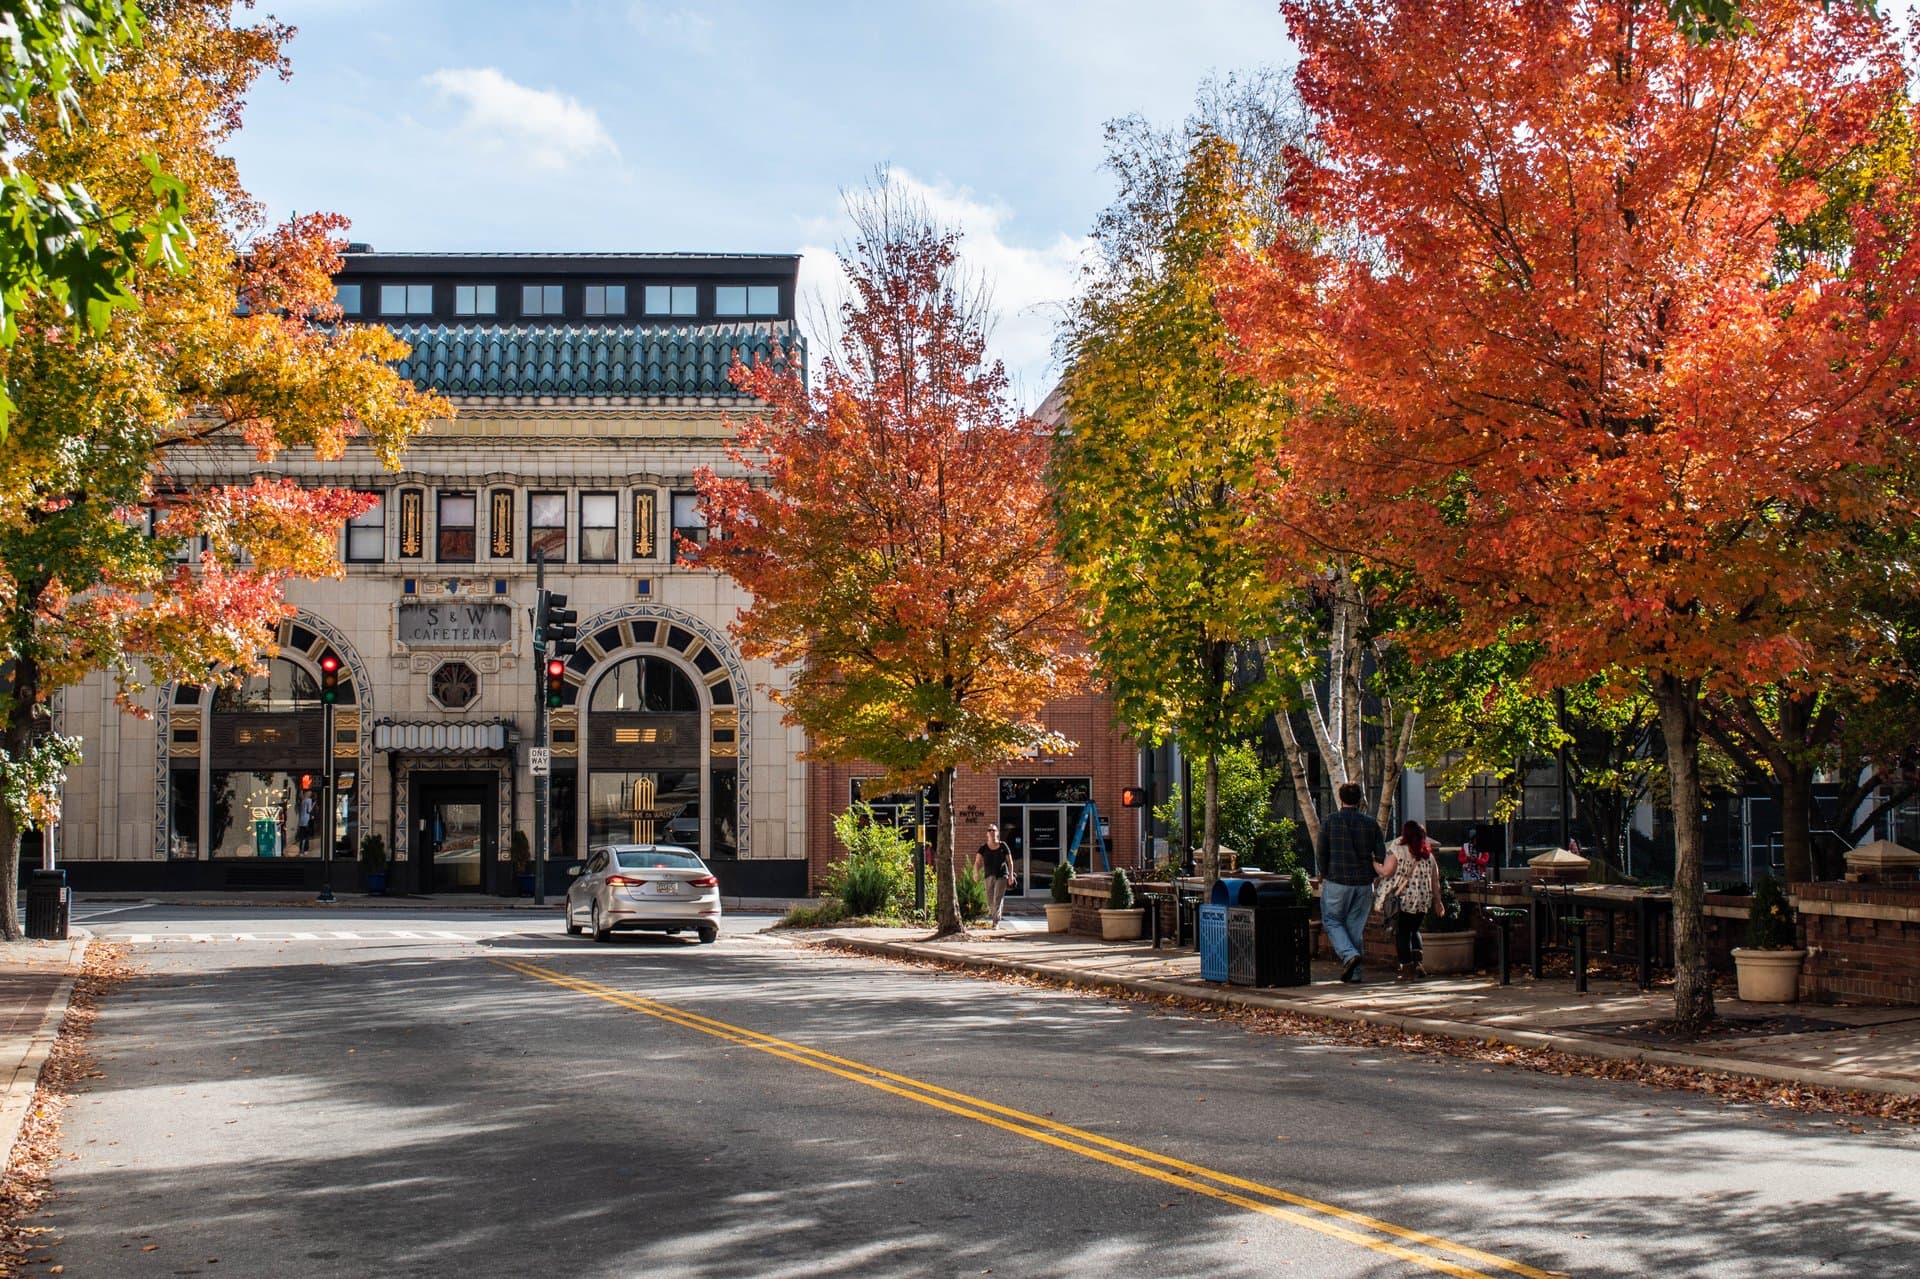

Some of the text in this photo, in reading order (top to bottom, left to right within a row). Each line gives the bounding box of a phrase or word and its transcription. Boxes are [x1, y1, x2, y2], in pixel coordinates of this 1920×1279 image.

[427, 608, 486, 626] S & W
[414, 628, 498, 641] CAFETERIA
[531, 757, 548, 765] WAY
